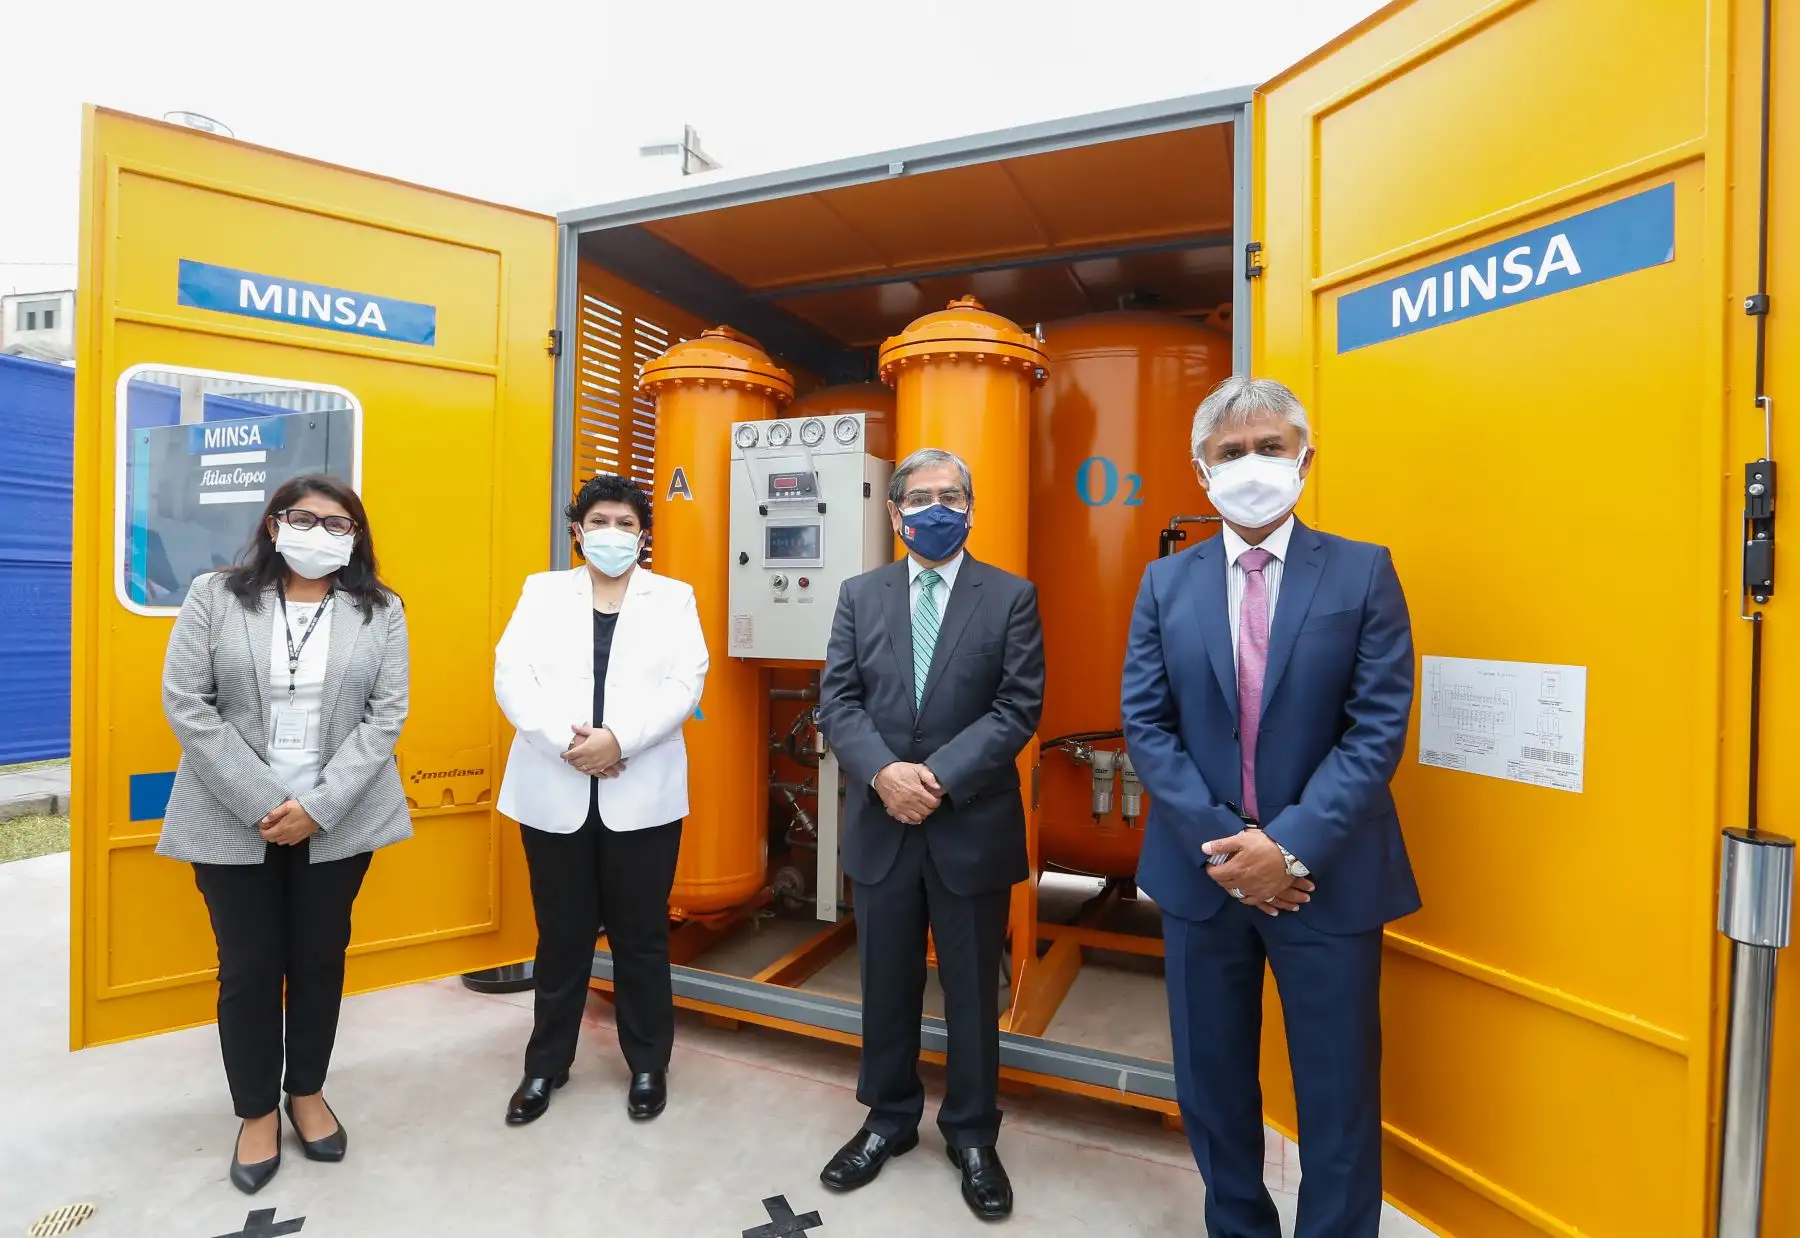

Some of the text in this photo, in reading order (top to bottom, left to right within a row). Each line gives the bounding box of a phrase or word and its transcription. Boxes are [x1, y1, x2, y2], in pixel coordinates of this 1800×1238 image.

[1391, 233, 1582, 329] MINSA
[238, 278, 387, 332] MINSA
[204, 424, 262, 449] MINSA
[199, 467, 267, 487] Atlas Copco
[666, 466, 695, 502] A
[421, 768, 485, 780] modasa
